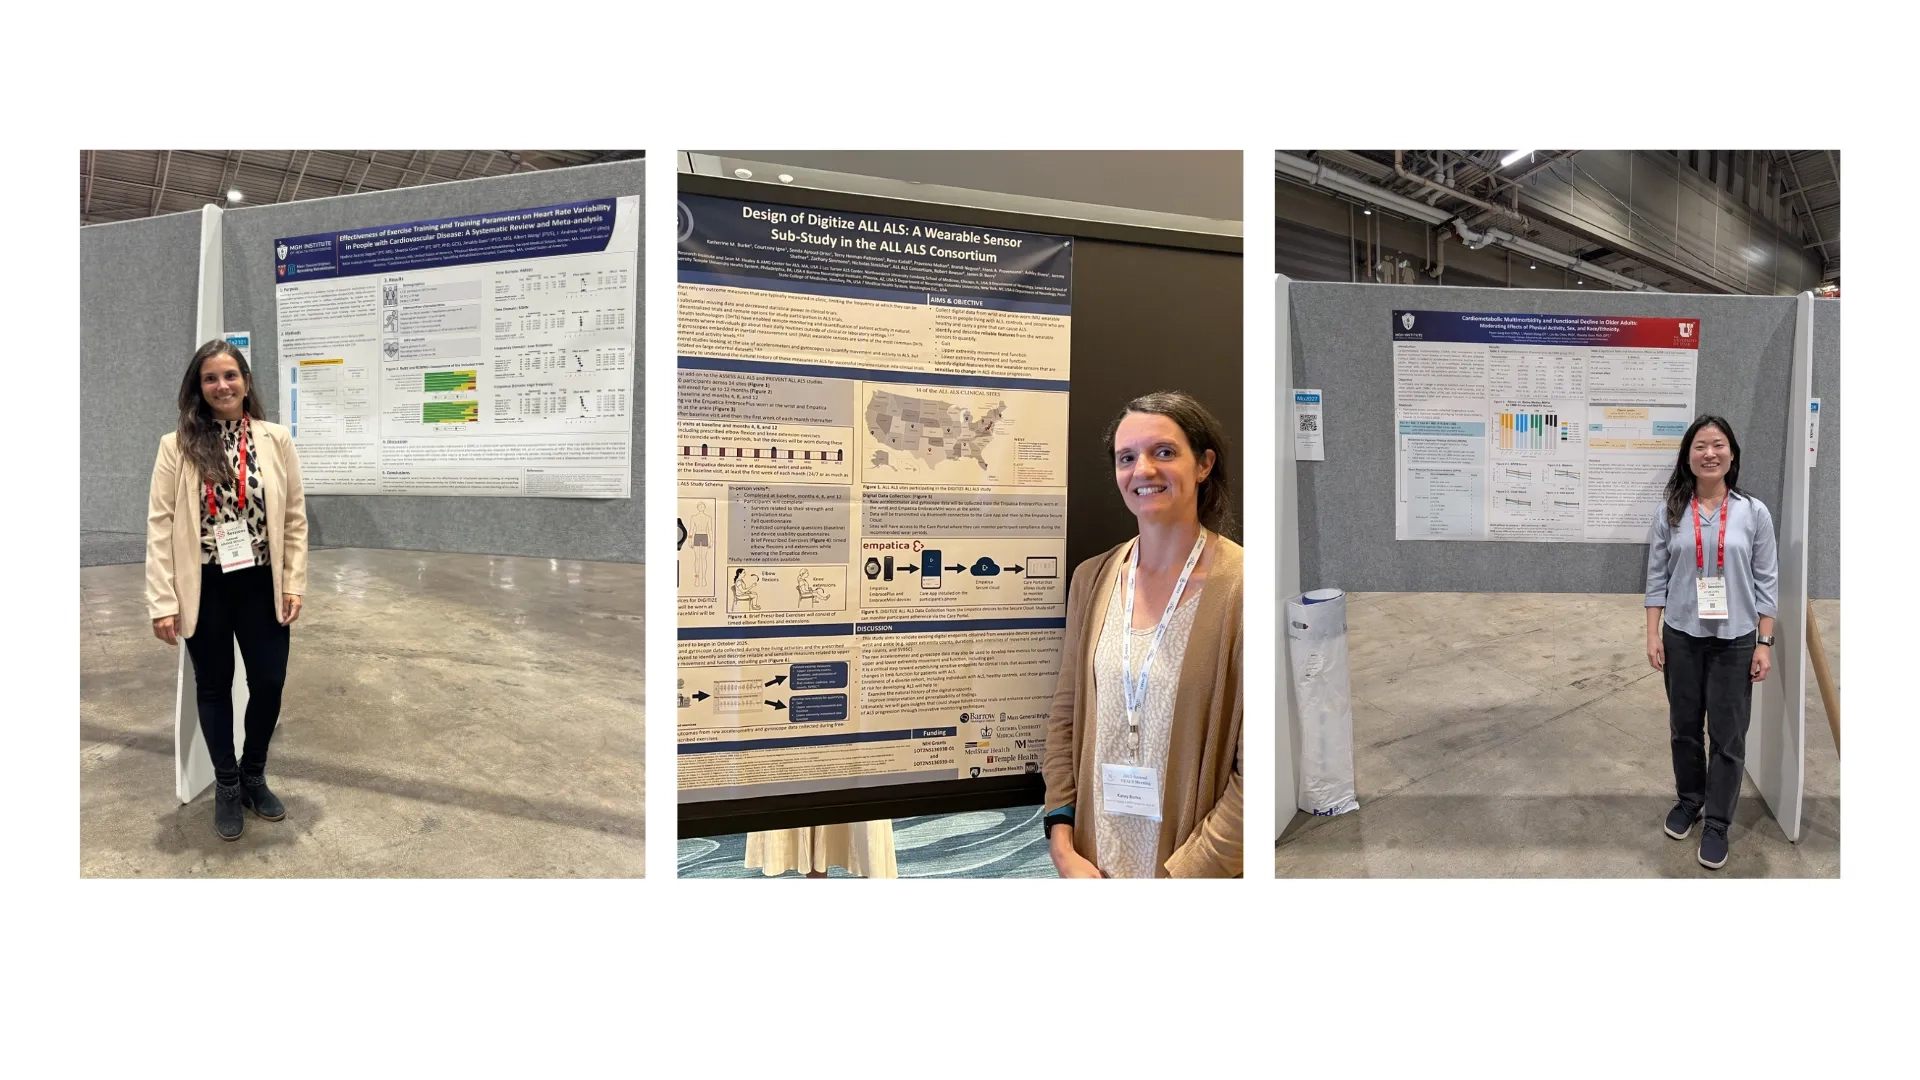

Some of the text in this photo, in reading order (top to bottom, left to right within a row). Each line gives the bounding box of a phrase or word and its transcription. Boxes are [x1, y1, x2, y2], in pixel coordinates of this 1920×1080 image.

[340, 232, 378, 241] Effectiveness
[387, 227, 412, 235] Exercise
[454, 219, 480, 228] Training
[482, 215, 520, 224] Parameters
[573, 204, 611, 214] Variability
[352, 241, 373, 249] People
[389, 234, 436, 245] Cardiovascular
[437, 231, 464, 239] Disease:
[472, 225, 508, 236] Systematic
[510, 222, 535, 231] Review
[552, 215, 603, 226] Meta-analysis
[743, 206, 1022, 248] Design of Digitize ALL ALS: A Wearable Sensor
[304, 241, 332, 249] INSTITUTE
[771, 228, 997, 263] Sub-Study in the ALL ALS Consortium
[953, 298, 983, 306] OBJECTIVE
[863, 541, 910, 551] empatica
[994, 755, 1016, 763] Temple
